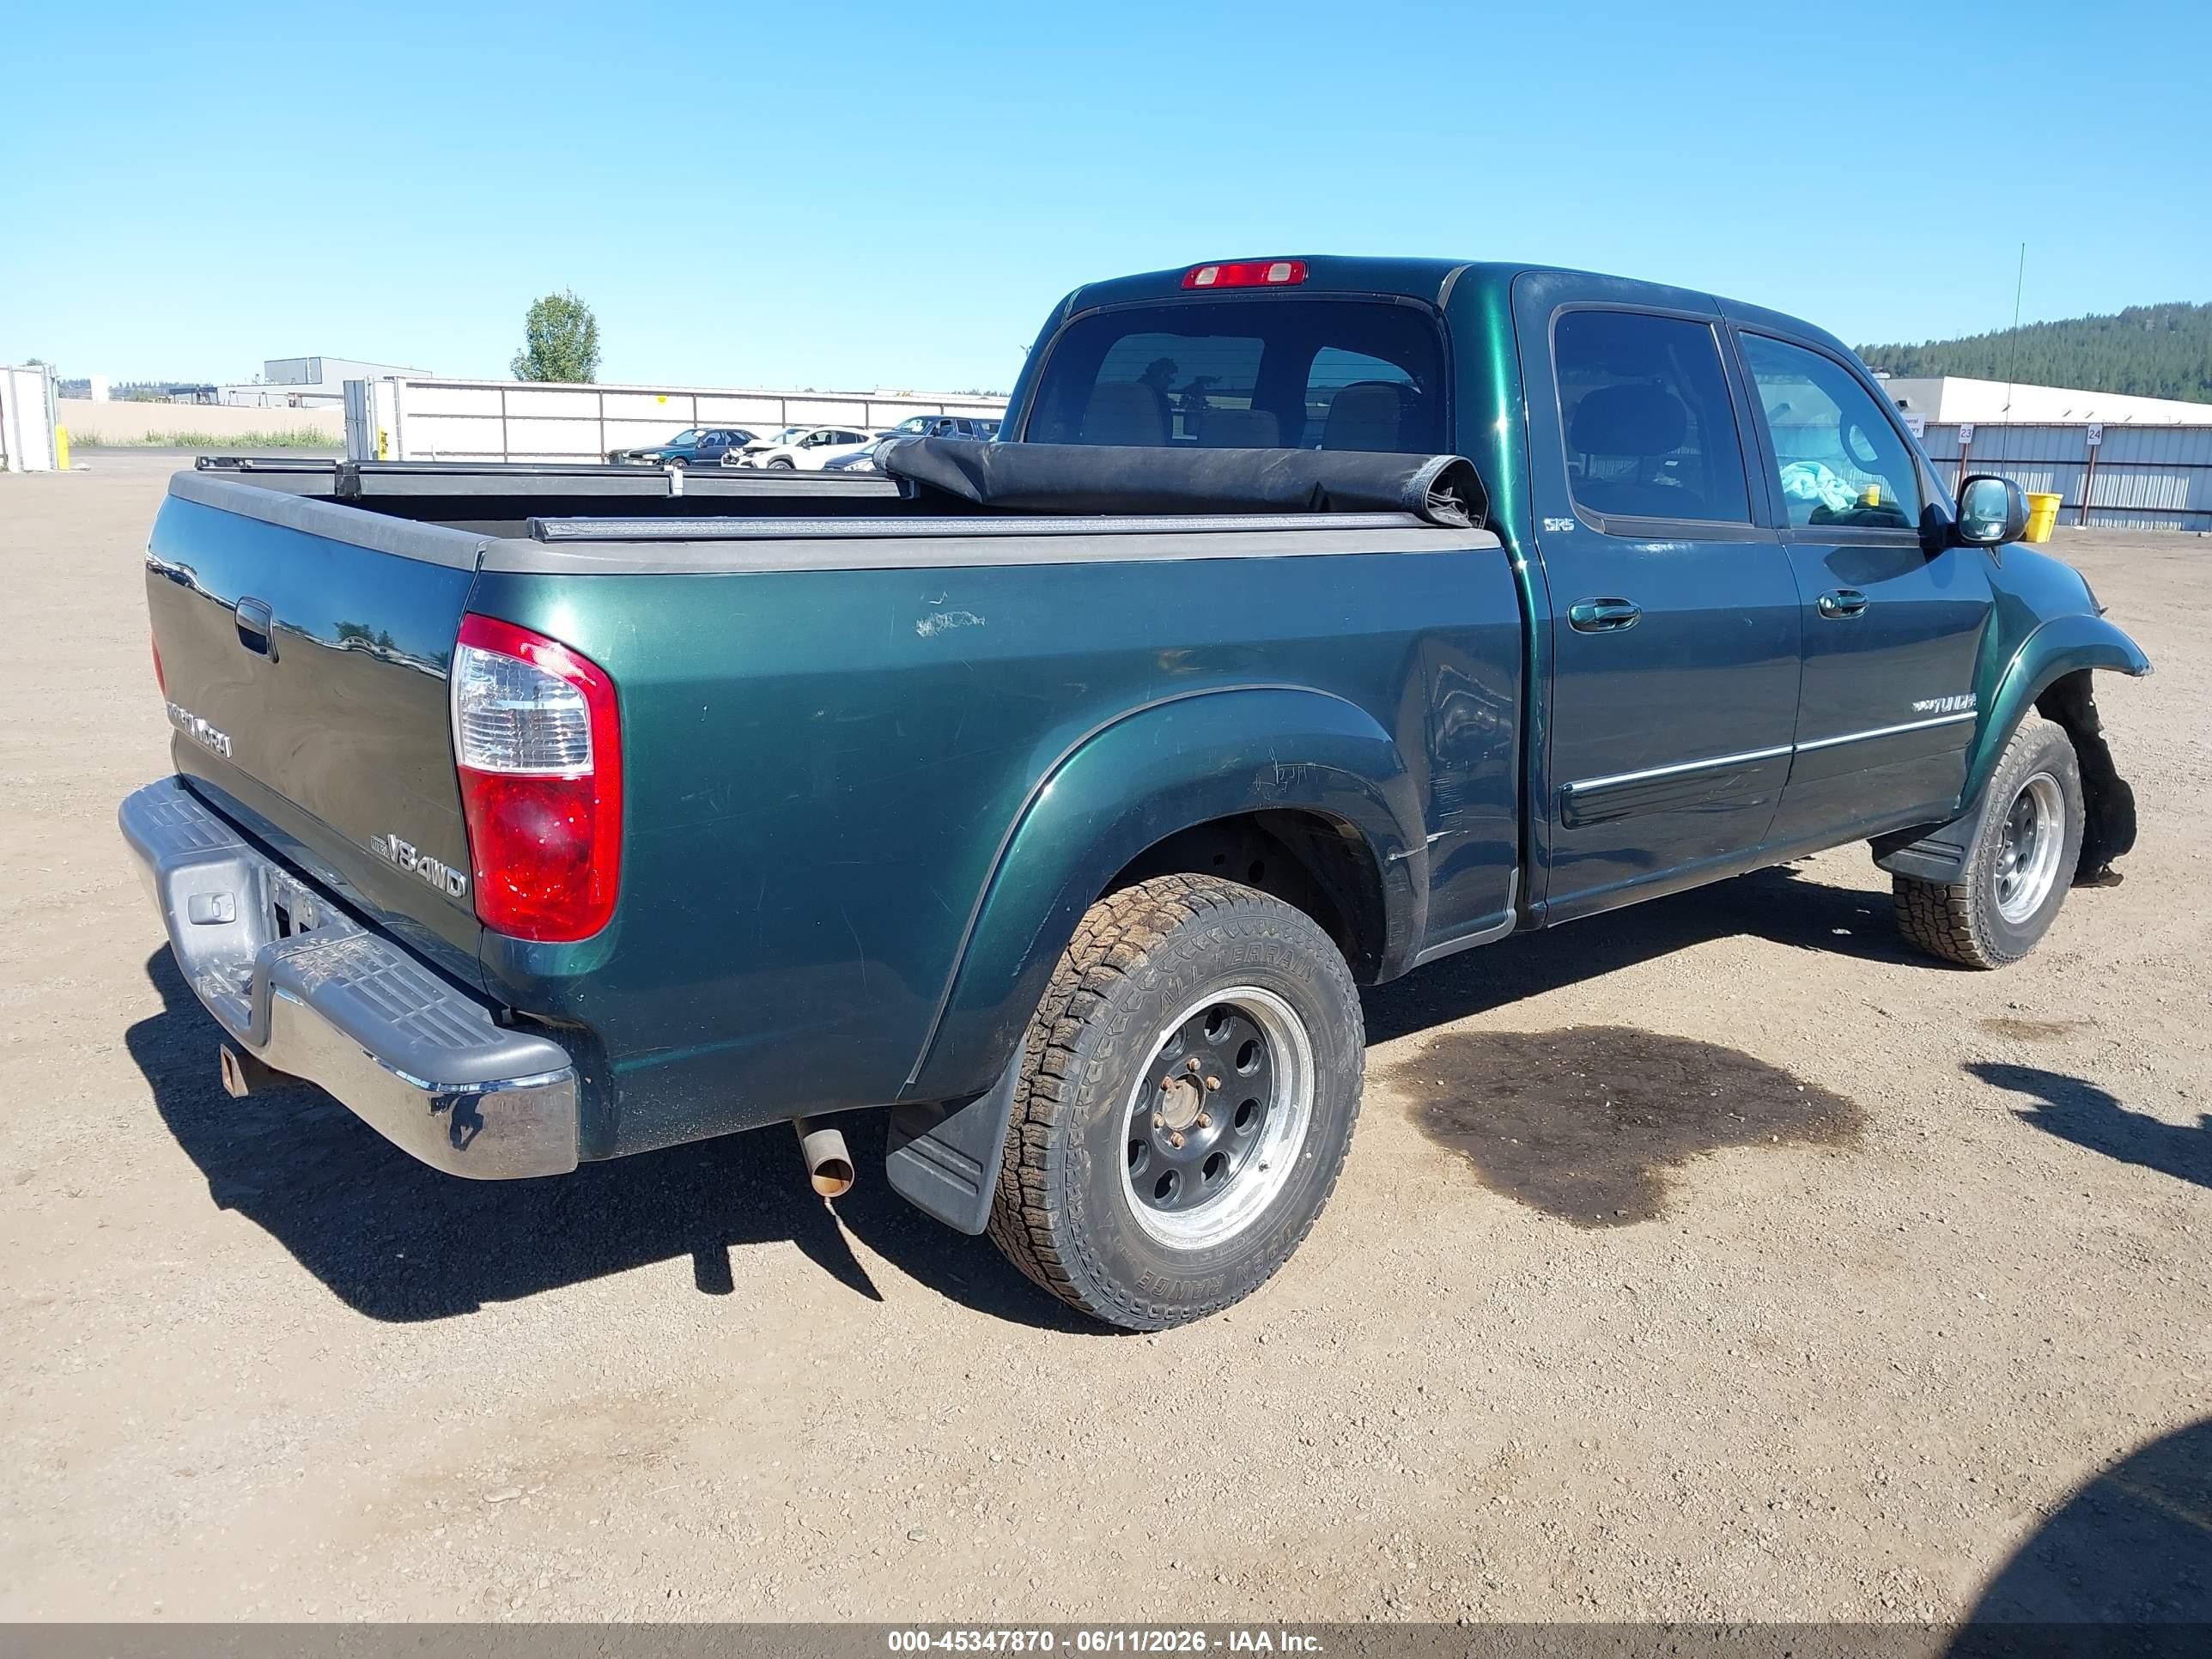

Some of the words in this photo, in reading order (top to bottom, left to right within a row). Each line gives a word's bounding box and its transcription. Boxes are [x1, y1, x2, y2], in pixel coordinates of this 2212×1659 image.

[1960, 428, 1972, 439] 23
[2088, 428, 2101, 441] 24
[1213, 943, 1317, 983] TERRAIN
[1134, 1269, 1227, 1301] RANGE
